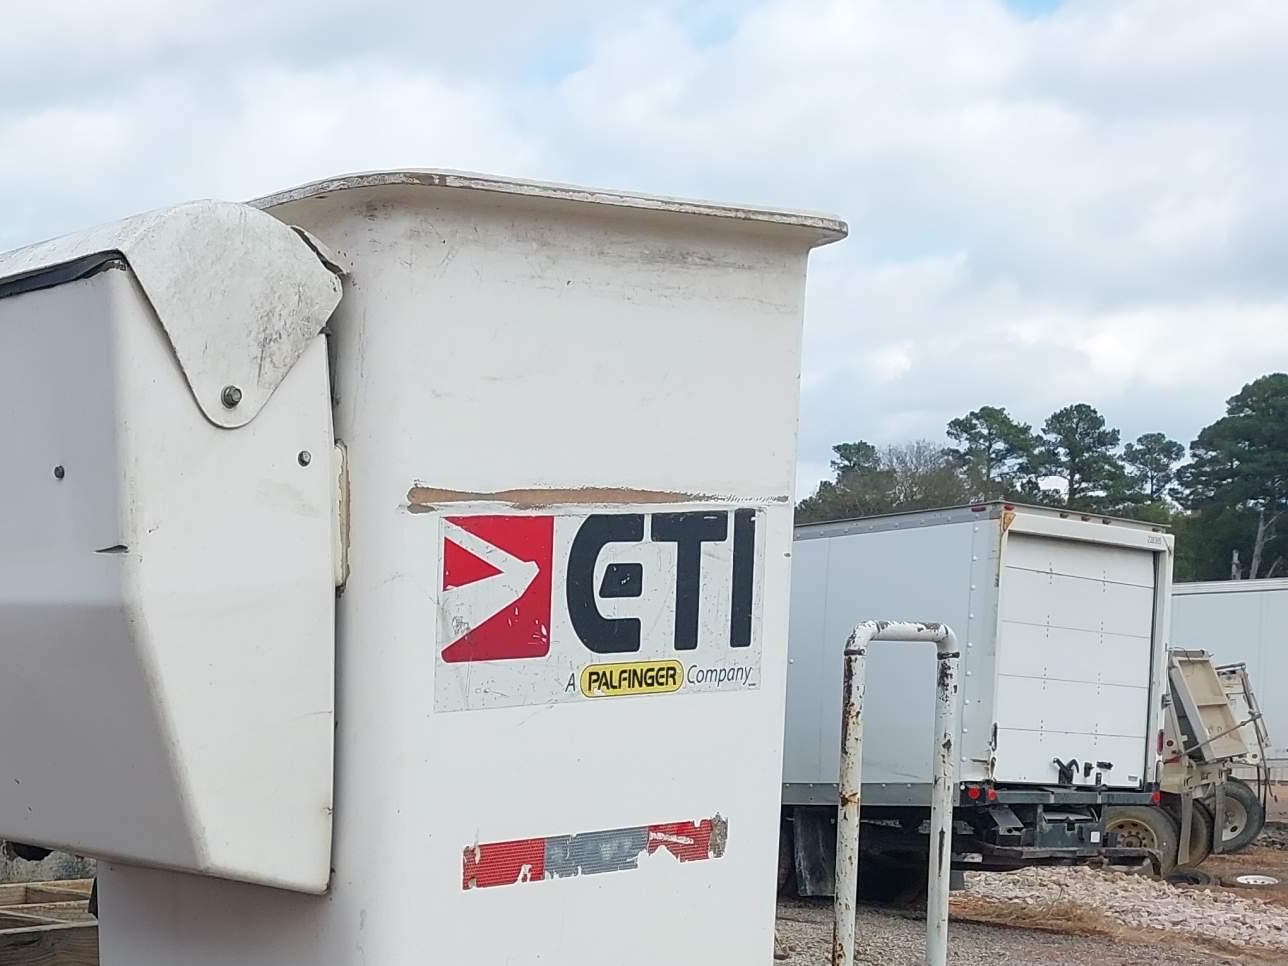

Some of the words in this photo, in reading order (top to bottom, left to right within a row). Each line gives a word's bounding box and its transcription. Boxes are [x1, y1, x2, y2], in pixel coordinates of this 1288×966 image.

[566, 508, 756, 655] ETI
[565, 673, 576, 693] A
[588, 666, 677, 692] PALFINGER
[687, 664, 752, 687] Company
